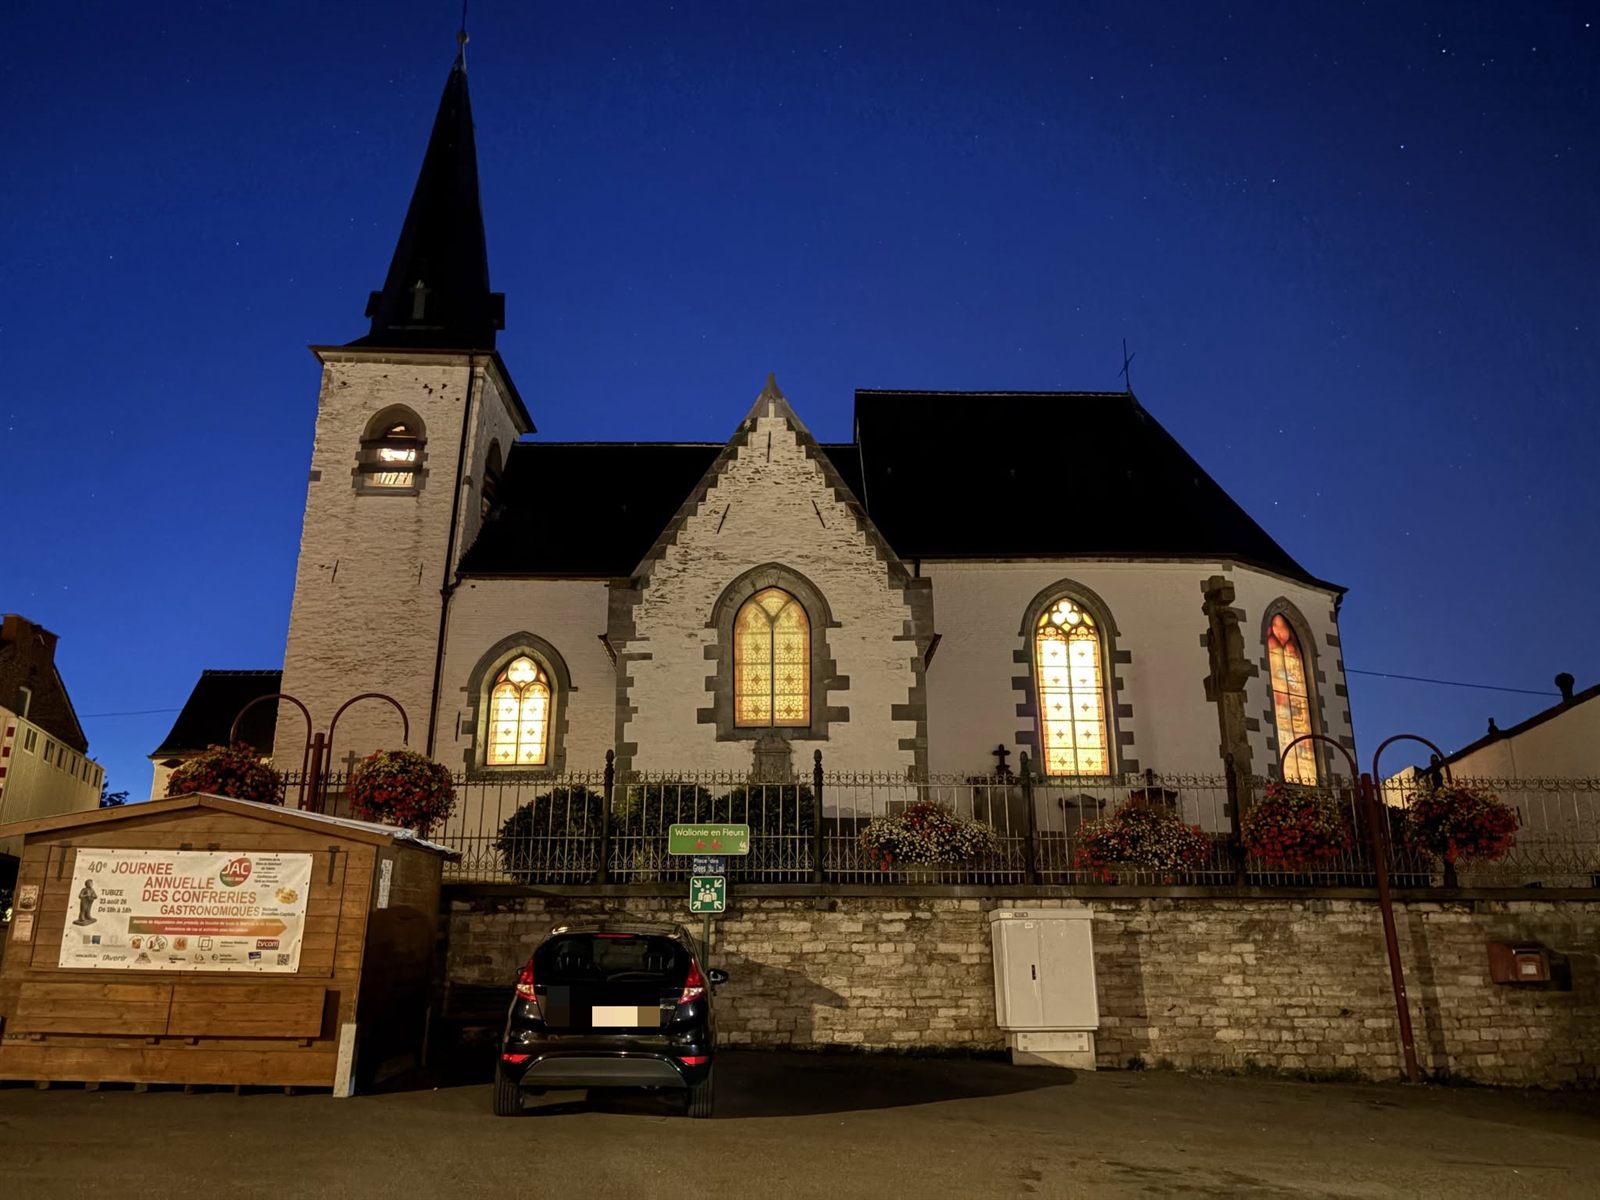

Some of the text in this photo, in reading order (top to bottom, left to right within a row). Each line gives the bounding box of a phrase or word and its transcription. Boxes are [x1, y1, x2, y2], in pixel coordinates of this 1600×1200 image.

[675, 828, 709, 837] Wallonie
[722, 828, 744, 837] Fleurs
[111, 861, 174, 875] JOURNEE
[221, 862, 250, 875] JAC
[144, 876, 215, 890] ANNUELLE
[142, 890, 257, 904] DES CONFRERIES
[160, 904, 260, 917] GASTRONOMIQUES
